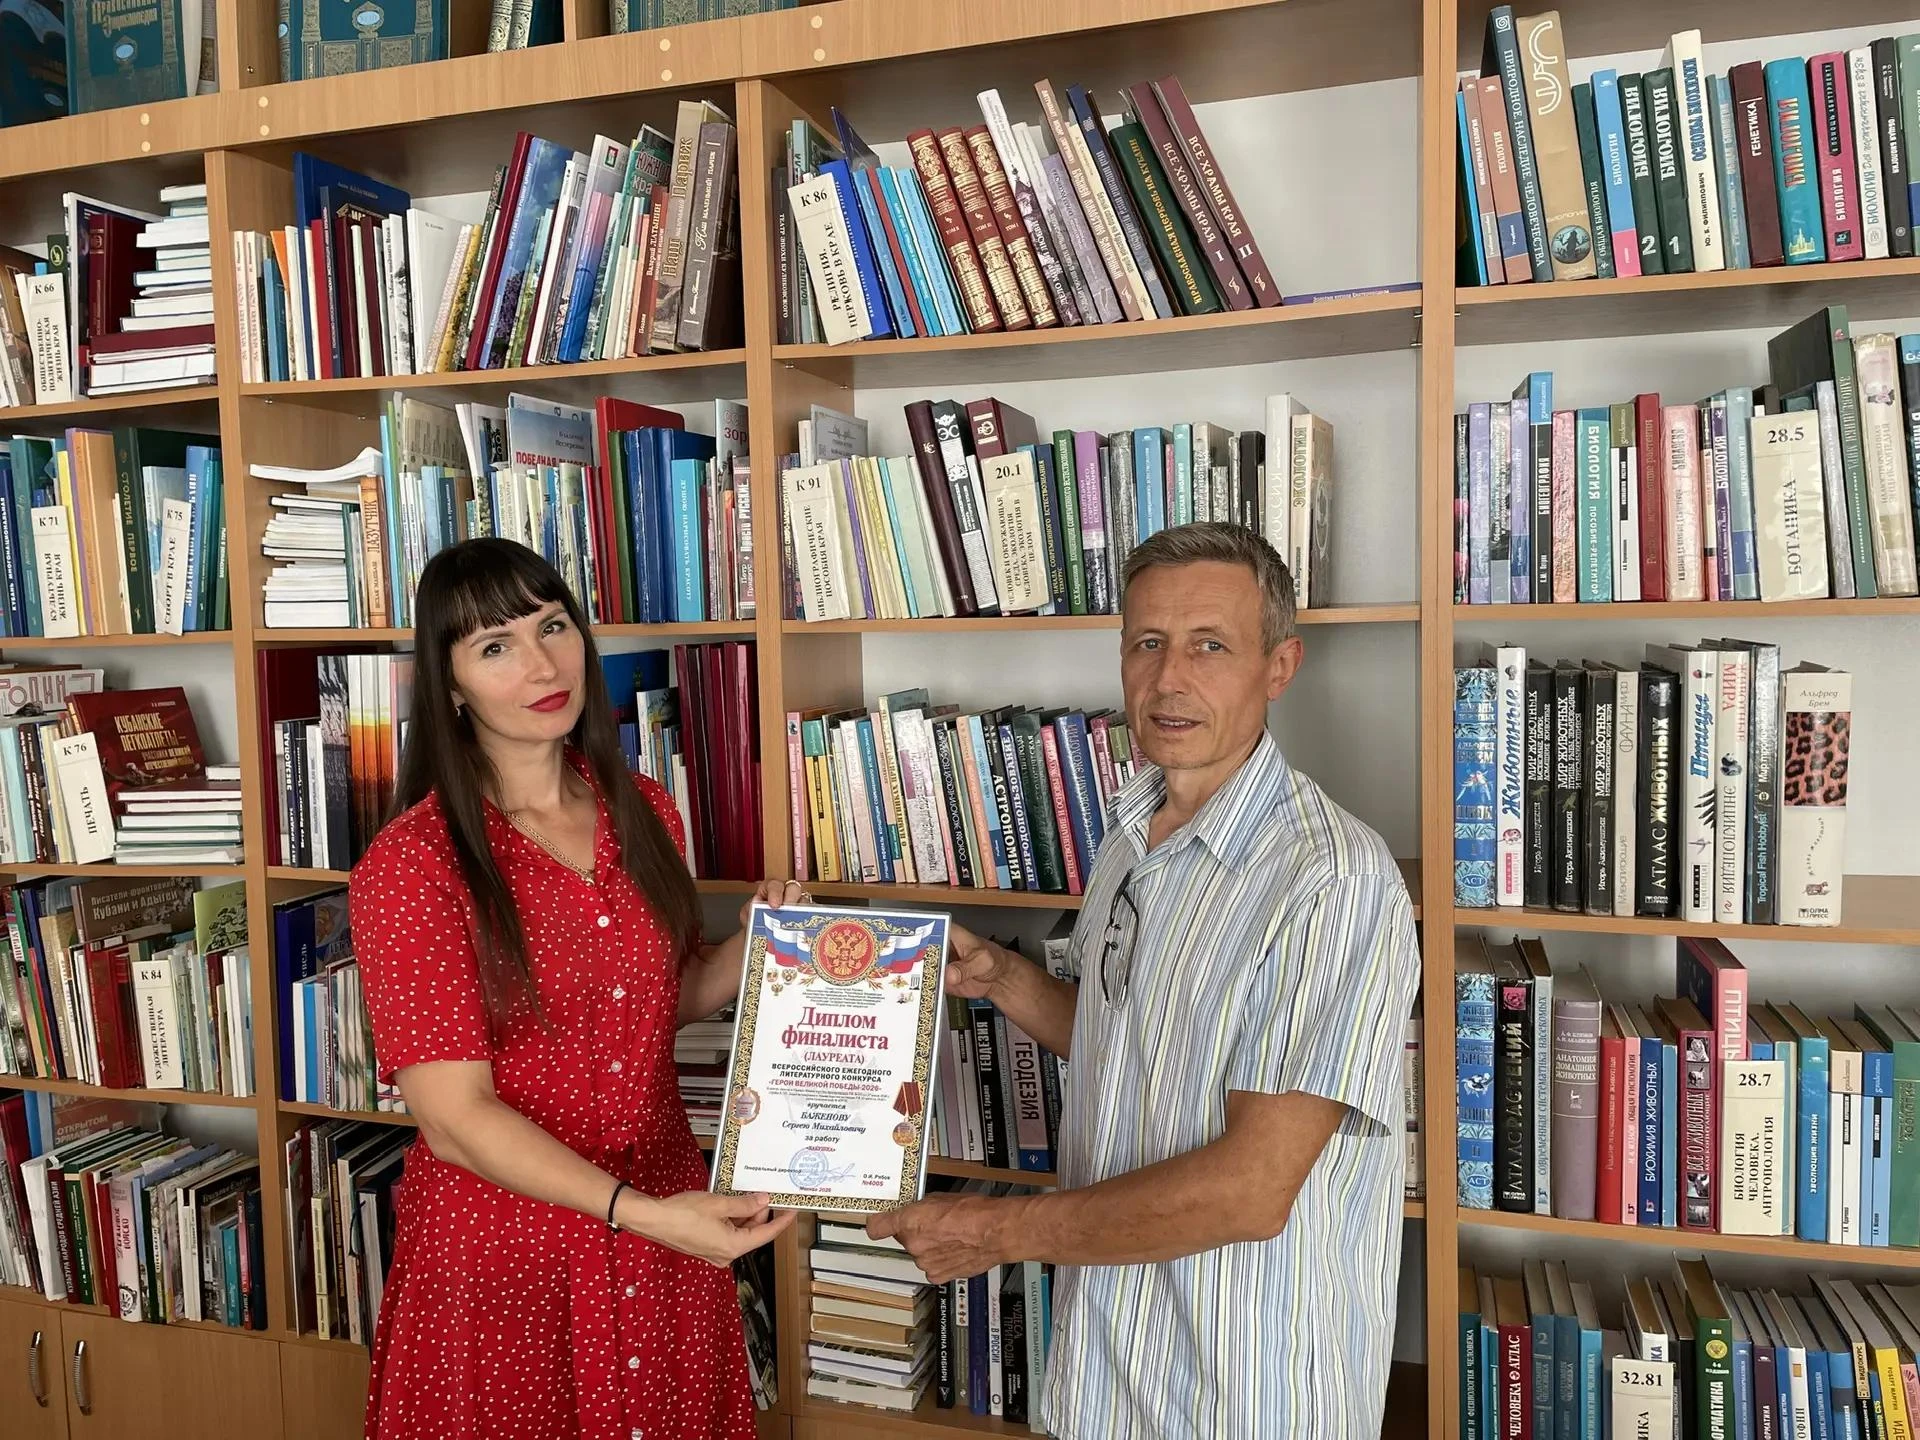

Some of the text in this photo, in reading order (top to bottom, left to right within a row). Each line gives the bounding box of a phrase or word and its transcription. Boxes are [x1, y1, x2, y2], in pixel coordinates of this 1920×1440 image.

[1494, 130, 1508, 174] ГЕОЛОГИЯ
[1624, 86, 1649, 179] БИОЛОГИЯ
[1653, 86, 1677, 181] БИОЛОГИЯ
[1689, 117, 1708, 162] ОСНОВЫ
[1746, 101, 1762, 157] ГЕНЕТИКА
[1777, 97, 1806, 188] БИОЛОГИЯ
[1188, 134, 1242, 239] ВСЕ ХРАМЫ КРАЯ
[1608, 133, 1623, 186] БИОЛОГИЯ
[662, 136, 693, 279] Наш Париж
[800, 188, 828, 207] К 86
[1162, 141, 1216, 244] ВСЕ ХРАМЫ КРАЯ
[1589, 181, 1604, 224] БИОЛОГИЯ
[1699, 172, 1709, 226] ФИЛИППОВИЧ
[1832, 167, 1846, 221] БИОЛОГИЯ
[1861, 171, 1879, 226] БИОЛОГИЯ
[1523, 183, 1546, 268] ЧЕЛОВЕЧЕСТВА
[1641, 235, 1656, 256] 2
[1669, 236, 1681, 255] 1
[646, 241, 656, 276] Валерий
[819, 248, 841, 311] РЕЛИГИЯ.
[824, 222, 858, 328] ЦЕРКОВЬ КРАЕ
[35, 284, 55, 294] К 66
[45, 317, 56, 391] ПОЛИТИЧЕСКАЯ
[53, 323, 65, 383] ЖИЗНЬ КРАЯ
[1767, 427, 1804, 444] 28.5
[1839, 376, 1857, 443] ЗАПОВЕДНИКИ
[796, 477, 821, 492] К 91
[995, 464, 1022, 480] 20.1
[1293, 427, 1308, 509] ЭКОЛОГИЯ
[1538, 457, 1550, 515] БИОГЕОГРАФИЯ
[1715, 436, 1728, 490] БИОЛОГИЯ
[39, 516, 59, 527] К 71
[121, 472, 138, 573] СТОЛЕТИЕ ПЕРВОЕ
[166, 509, 183, 520] К 75
[363, 500, 380, 554] ЛАЗУТЧИК
[740, 521, 752, 552] Просто
[997, 496, 1009, 558] ОКРУЖАЮЩАЯ
[1007, 513, 1018, 557] ЭКОЛОГИЯ
[1015, 506, 1026, 551] ЭКОЛОГИЯ
[1587, 425, 1600, 596] БИОЛОГИЯ ПОСОБИЕ-РЕПЕТИТОР
[1784, 479, 1801, 576] БОТАНИКА
[804, 505, 826, 617] БИБЛИОГРАФИЧЕСКИЕ
[815, 522, 833, 597] ПОСОБИЯ КРАЯ
[1025, 531, 1035, 561] ЦЕЛОМ
[45, 553, 57, 621] КУЛЬТУРНАЯ
[54, 553, 67, 619] ЖИЗНЬ КРАЯ
[164, 537, 176, 624] СПОРТ КРАЕ
[1722, 663, 1736, 712] МИРА
[1799, 689, 1840, 700] Альфред
[64, 743, 87, 756] К 76
[114, 713, 163, 733] КУБАНСКИЕ
[120, 729, 178, 751] ЛЕГКОАТЛЕТЫ
[1528, 691, 1538, 780] МИР ЖИВОТНЫХ
[1557, 697, 1568, 788] МИР ЖИВОТНЫХ
[1595, 703, 1606, 797] МИР ЖИВОТНЫХ
[1619, 704, 1634, 753] ФАУНА
[1690, 693, 1714, 780] Птицы
[283, 732, 292, 790] ЗВЕЗДОПАД
[1502, 689, 1522, 819] Животные
[1758, 764, 1768, 783] Мир
[81, 786, 97, 834] ПЕЧАТЬ
[993, 774, 1022, 880] АСТРОНОМИЯ
[1001, 734, 1035, 883] ПРИРОДОПОЛЬЗОВАНИЕ
[1650, 717, 1669, 889] АТЛАС ЖИВОТНЫХ
[1565, 810, 1573, 884] Игорь Акимушкин
[1723, 785, 1736, 894] ЭНЦИКЛОПЕДИЯ
[1757, 813, 1768, 904] Tropical Fish Hobbyist
[1599, 867, 1607, 891] Игорь
[93, 900, 130, 921] Кубани
[141, 969, 162, 981] К 84
[147, 996, 162, 1080] ХУДОЖЕСТВЕННАЯ
[158, 1008, 169, 1067] ЛИТЕРАТУРА
[782, 1025, 889, 1050] финалиста
[797, 1007, 877, 1030] Диплом
[772, 1063, 892, 1076] ВСЕРОССИЙСКОГО ЕЖЕГОДНОГО
[804, 1052, 865, 1064] (ЛАУРЕАТА)
[977, 1021, 992, 1072] ГЕОДЕЗИЯ
[1556, 1054, 1597, 1064] АНАТОМИЯ
[1556, 1063, 1597, 1072] ДОМАШНИХ
[780, 1070, 881, 1082] ЛИТЕРАТУРНОГО КОНКУРСА
[794, 1080, 828, 1088] ВЕЛИКОЙ
[1015, 1042, 1039, 1120] ГЕОДЕЗИЯ
[1540, 1050, 1549, 1112] систематика
[1555, 1071, 1597, 1081] ЖИВОТНЫХ
[1628, 1054, 1636, 1096] ГИСТОЛОГИЯ
[1738, 1072, 1772, 1087] 28.7
[57, 1115, 108, 1136] ОТКРЫТОМ
[782, 1120, 866, 1134] Сергею Михайловичу
[800, 1111, 851, 1121] БАЖЕНОВУ
[1501, 1022, 1522, 1192] АТЛАС РАСТЕНИЙ
[1645, 1062, 1656, 1182] БИОХИМИЯ ЖИВОТНЫХ
[1687, 1090, 1704, 1172] ВСЕ ЖИВОТНЫХ
[1540, 1113, 1549, 1176] современная
[1733, 1132, 1745, 1200] БИОЛОГИЯ
[1749, 1132, 1759, 1201] ЧЕЛОВЕКА.
[1762, 1116, 1774, 1217] АНТРОПОЛОГИЯ
[1809, 1113, 1819, 1194] ЭВОЛЮЦИЯ ЖИЗНИ
[51, 1181, 60, 1198] АЗИИ
[1468, 1177, 1488, 1186] АСТ
[1012, 1301, 1024, 1339] ЧУДЕСА
[1537, 1333, 1549, 1344] 2
[992, 1335, 1000, 1363] РОССИИ
[1466, 1329, 1474, 1367] ЧЕЛОВЕКА
[1508, 1335, 1522, 1437] ЧЕЛОВЕКА АТЛАС
[1621, 1371, 1663, 1387] 32.81
